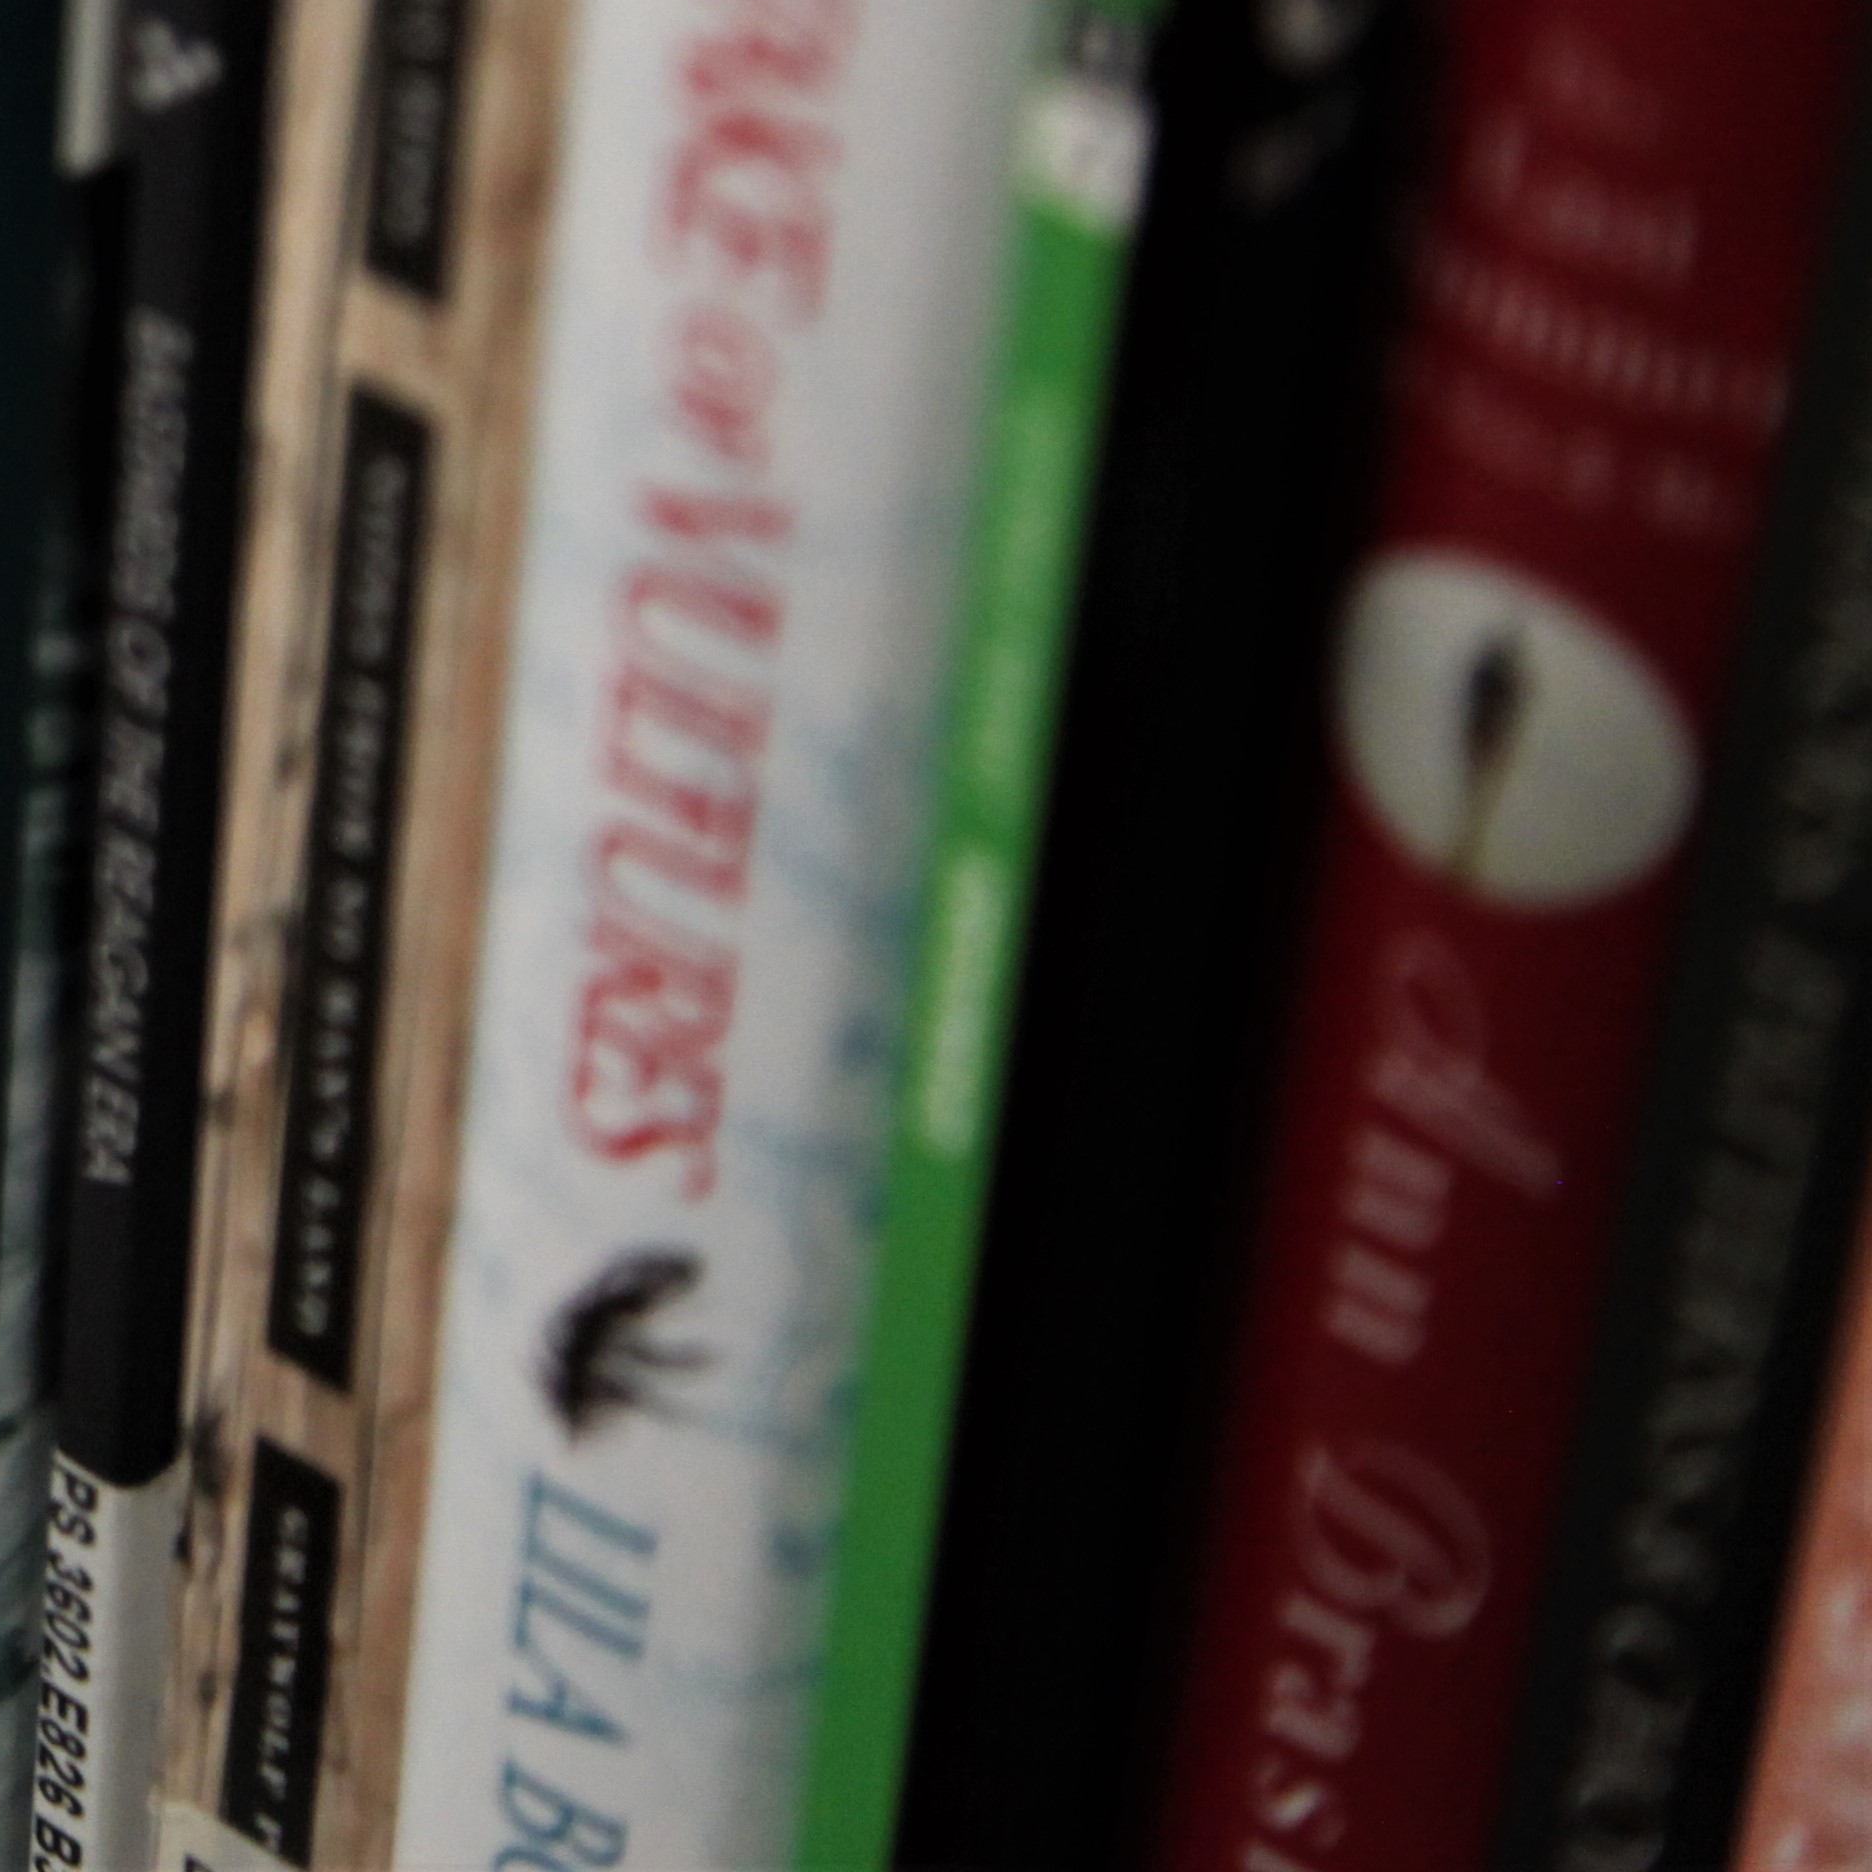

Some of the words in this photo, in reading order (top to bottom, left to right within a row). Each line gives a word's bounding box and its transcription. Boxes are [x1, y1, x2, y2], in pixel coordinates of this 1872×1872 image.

[89, 828, 157, 1086] REAGAN
[80, 1071, 140, 1188] ERA
[52, 1456, 99, 1549] PS
[501, 1463, 658, 1750] LILA
[1241, 1433, 1498, 1872] Bras
